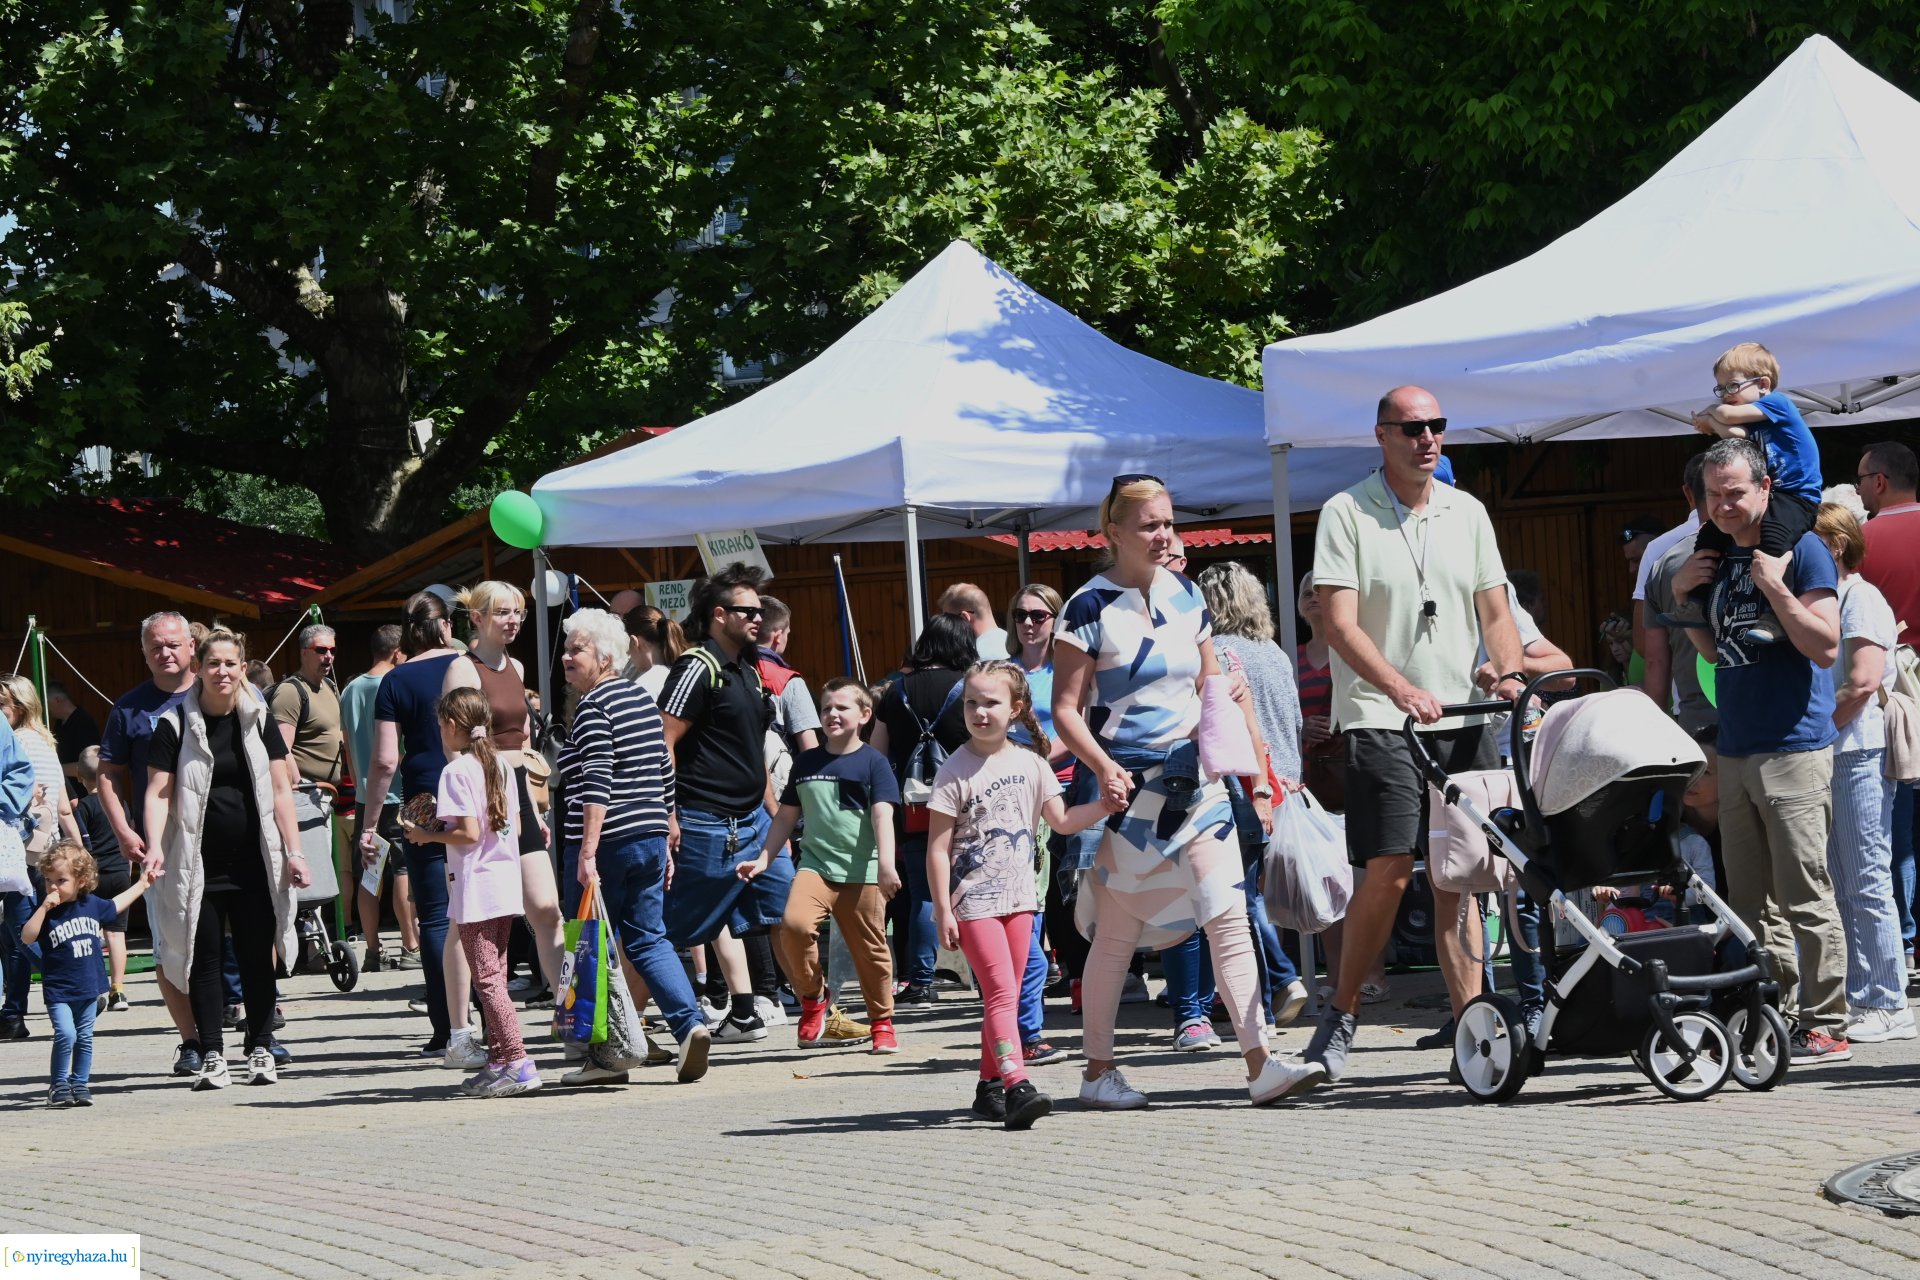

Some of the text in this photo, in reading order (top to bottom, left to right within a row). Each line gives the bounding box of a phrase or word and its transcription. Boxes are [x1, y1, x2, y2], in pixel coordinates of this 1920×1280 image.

[708, 530, 755, 557] KIRAKÓ
[659, 583, 686, 595] REND-
[961, 775, 1025, 814] GIRL POWER
[71, 938, 93, 958] NYC
